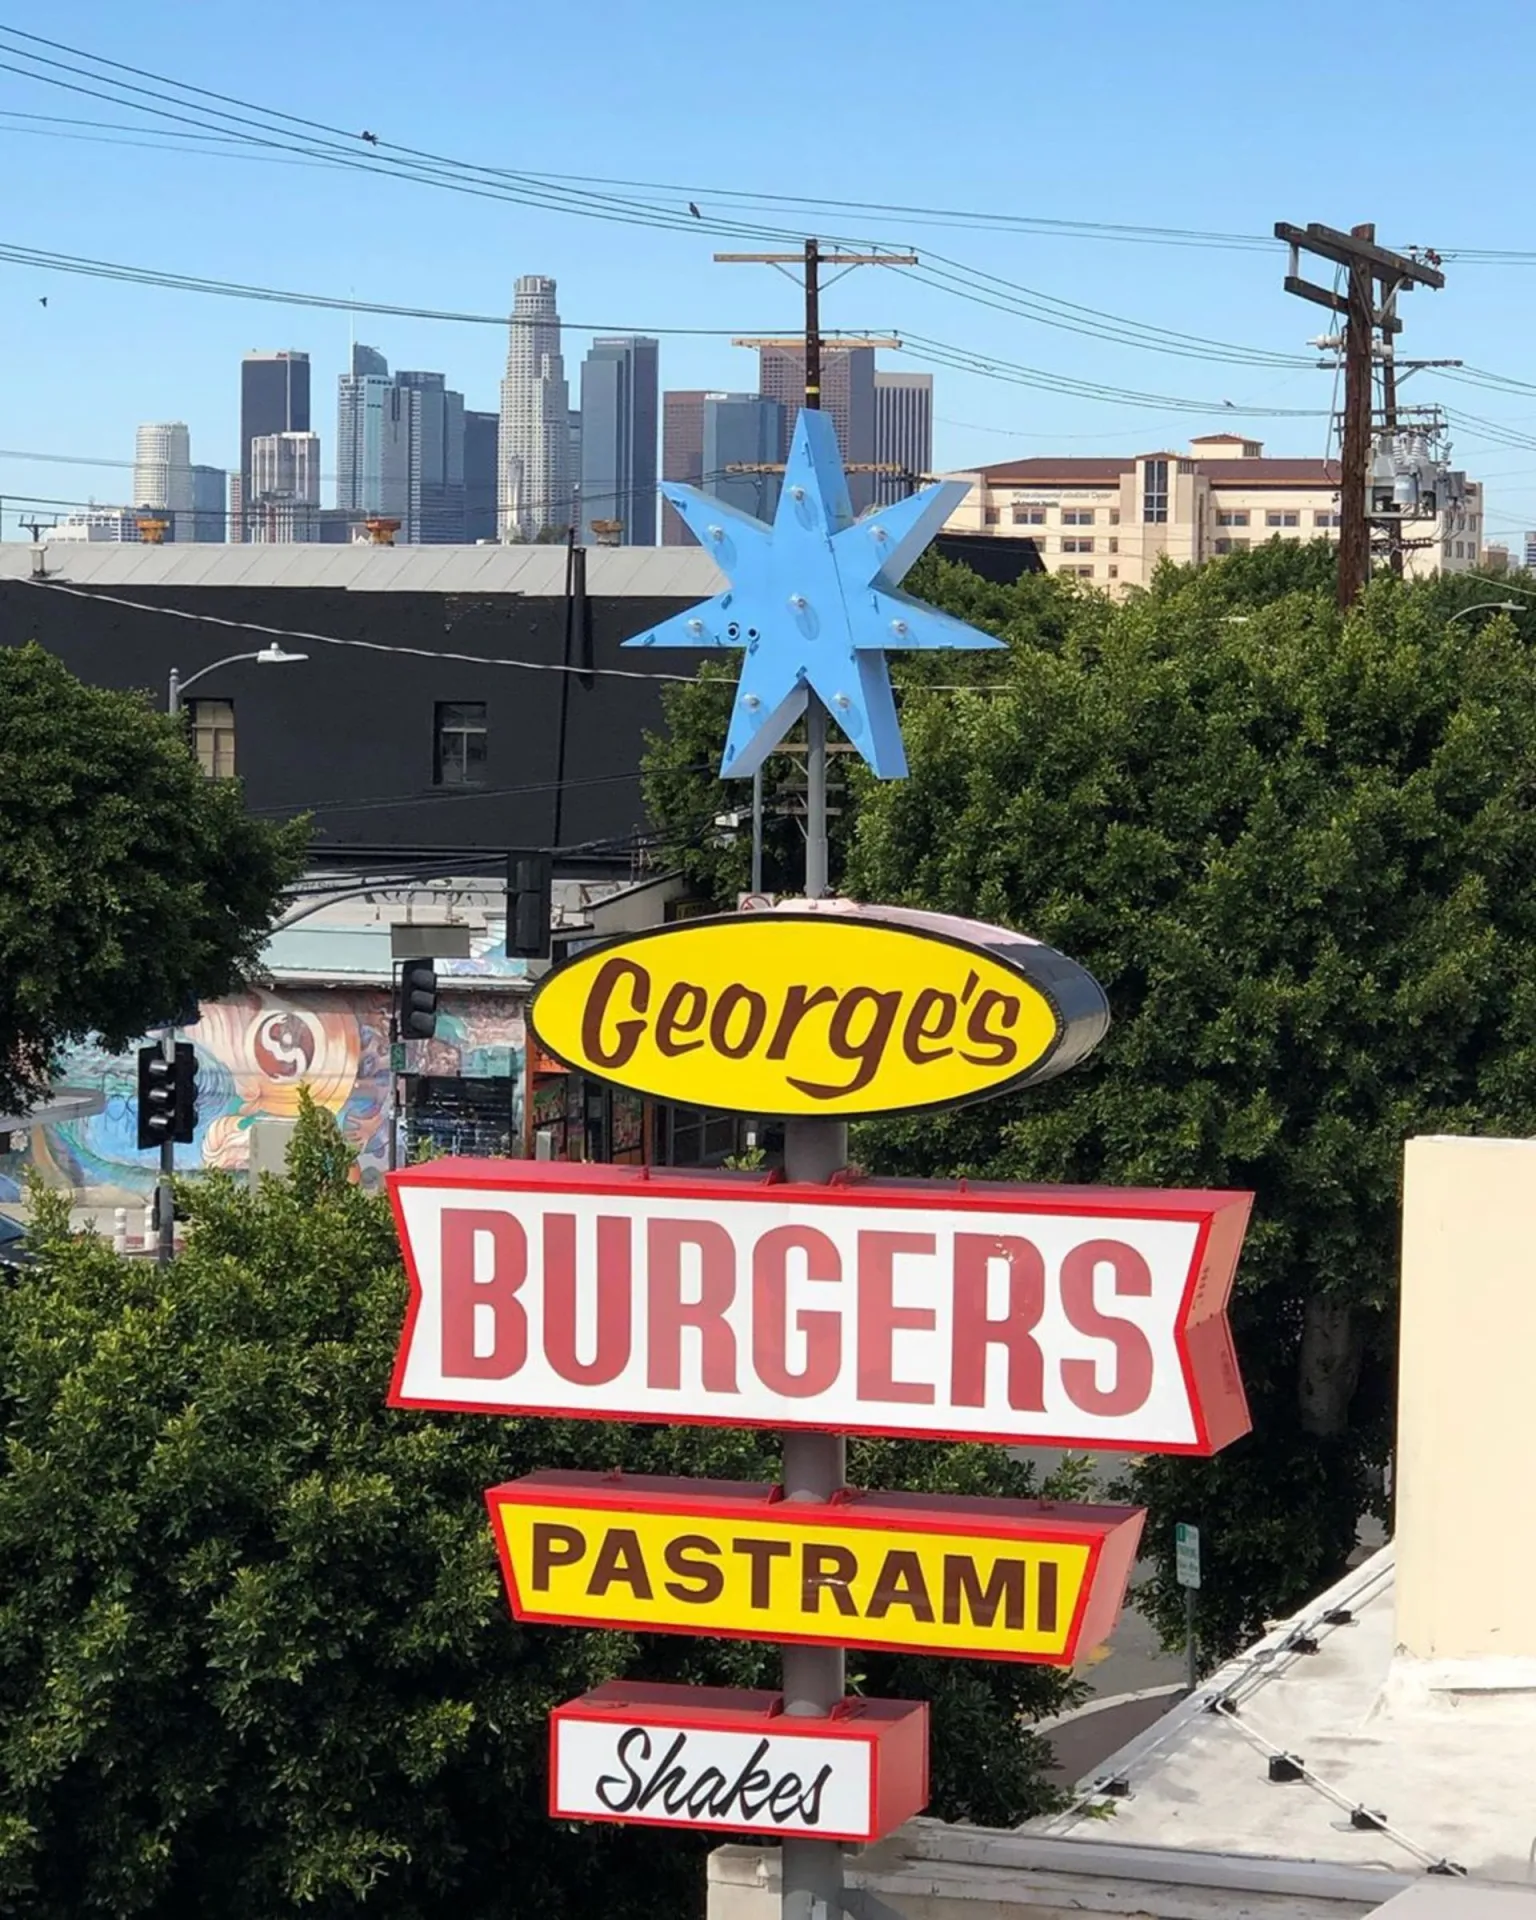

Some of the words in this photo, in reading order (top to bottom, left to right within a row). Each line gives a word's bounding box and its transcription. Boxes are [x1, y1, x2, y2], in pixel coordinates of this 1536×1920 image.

[582, 957, 1020, 1100] George's
[441, 1208, 1153, 1417] BURGERS
[532, 1522, 1058, 1633] PASTRAMI
[595, 1727, 833, 1825] Shakes
